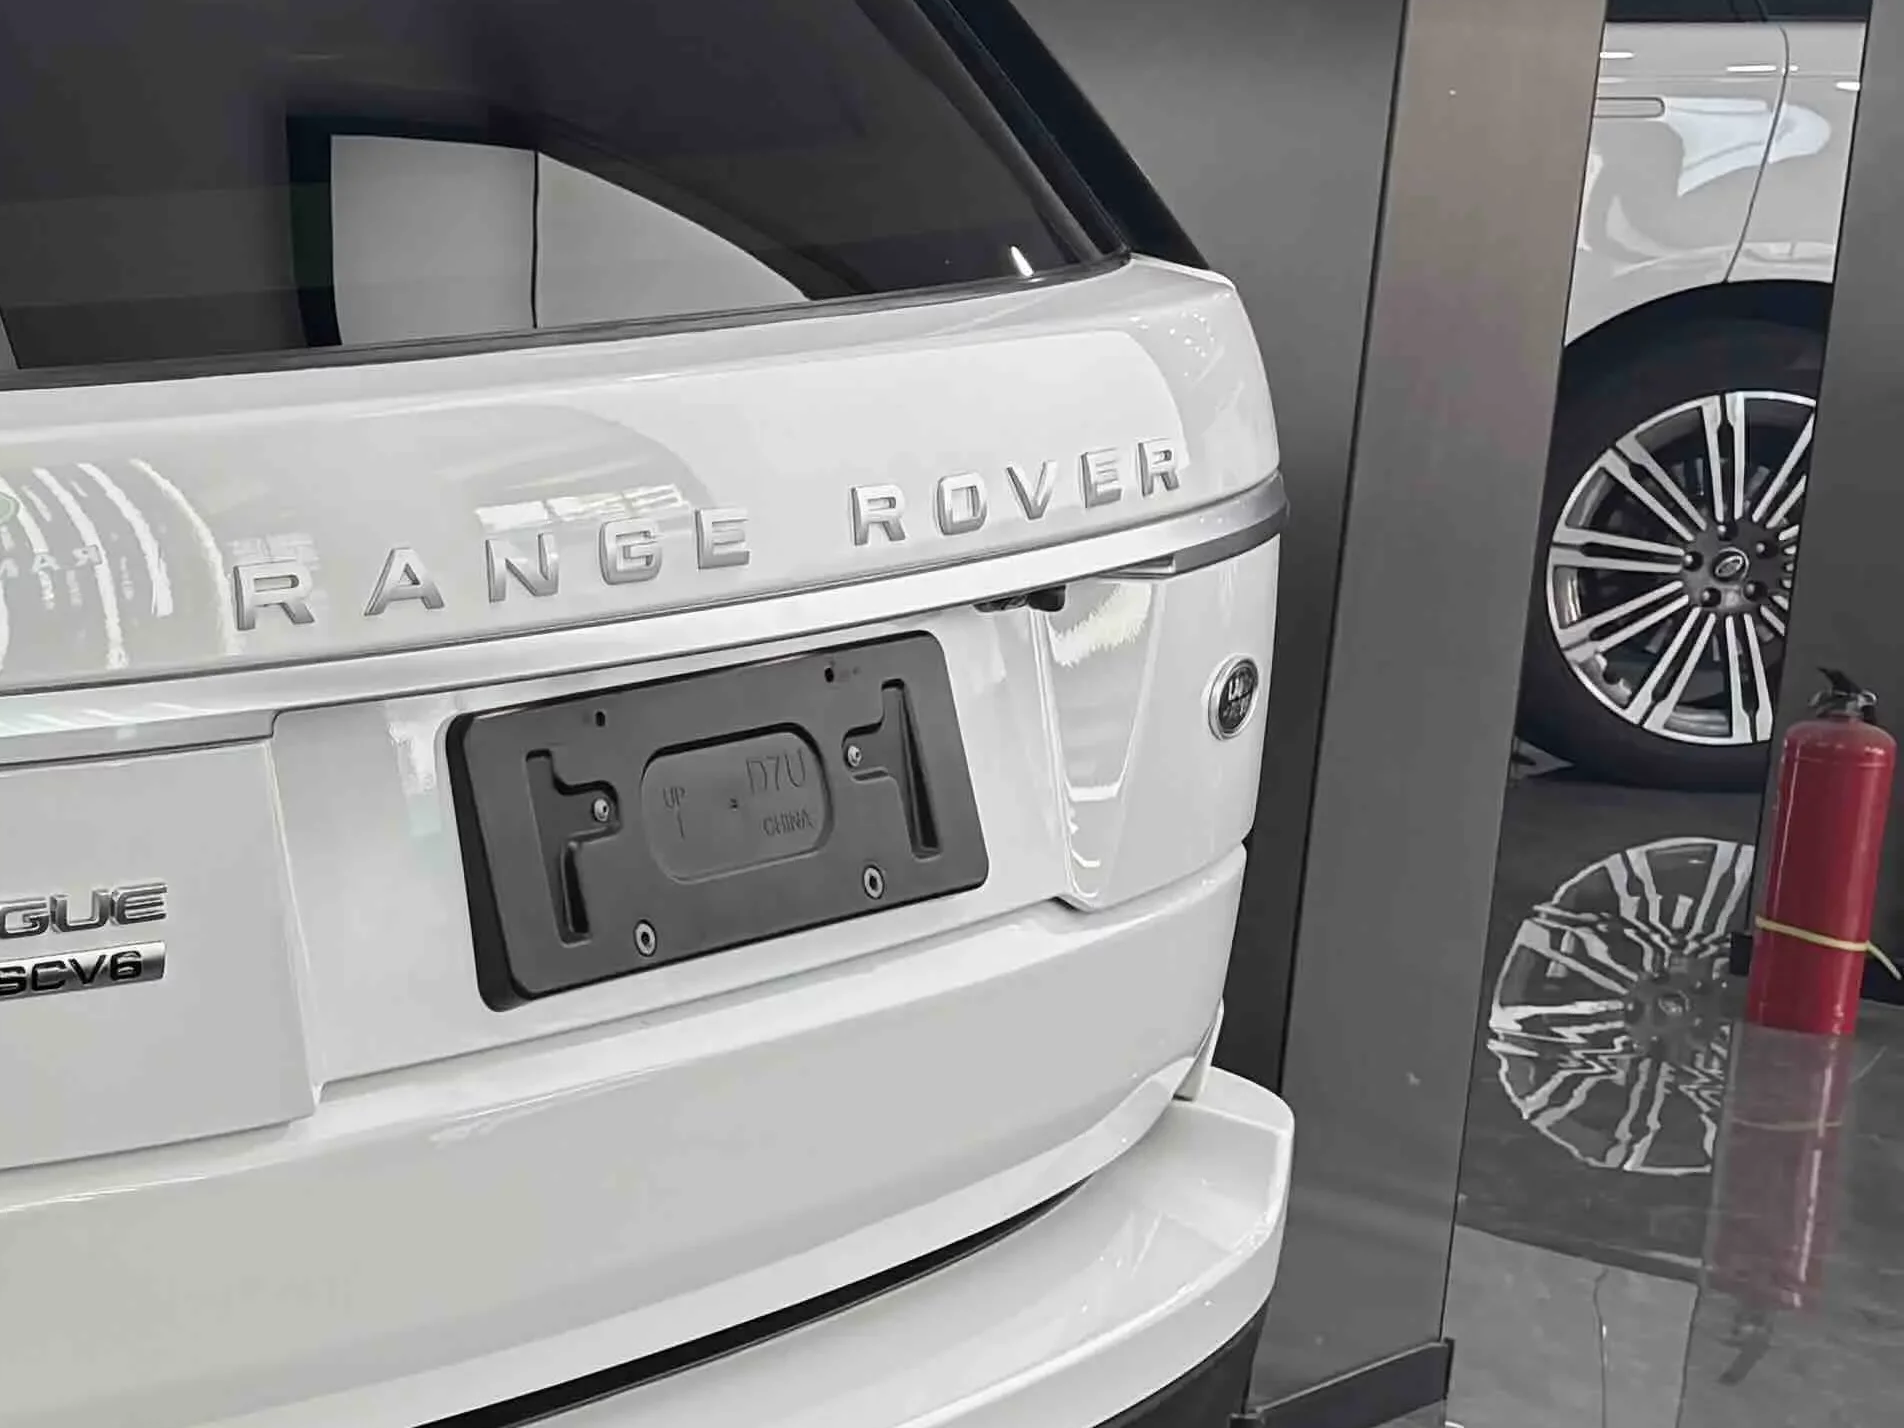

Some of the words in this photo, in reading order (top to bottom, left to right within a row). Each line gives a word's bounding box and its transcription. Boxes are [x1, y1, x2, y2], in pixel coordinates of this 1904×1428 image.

[232, 507, 752, 631] RANGE
[848, 437, 1180, 546] ROVER
[662, 786, 686, 810] UP
[762, 808, 815, 838] CHINA
